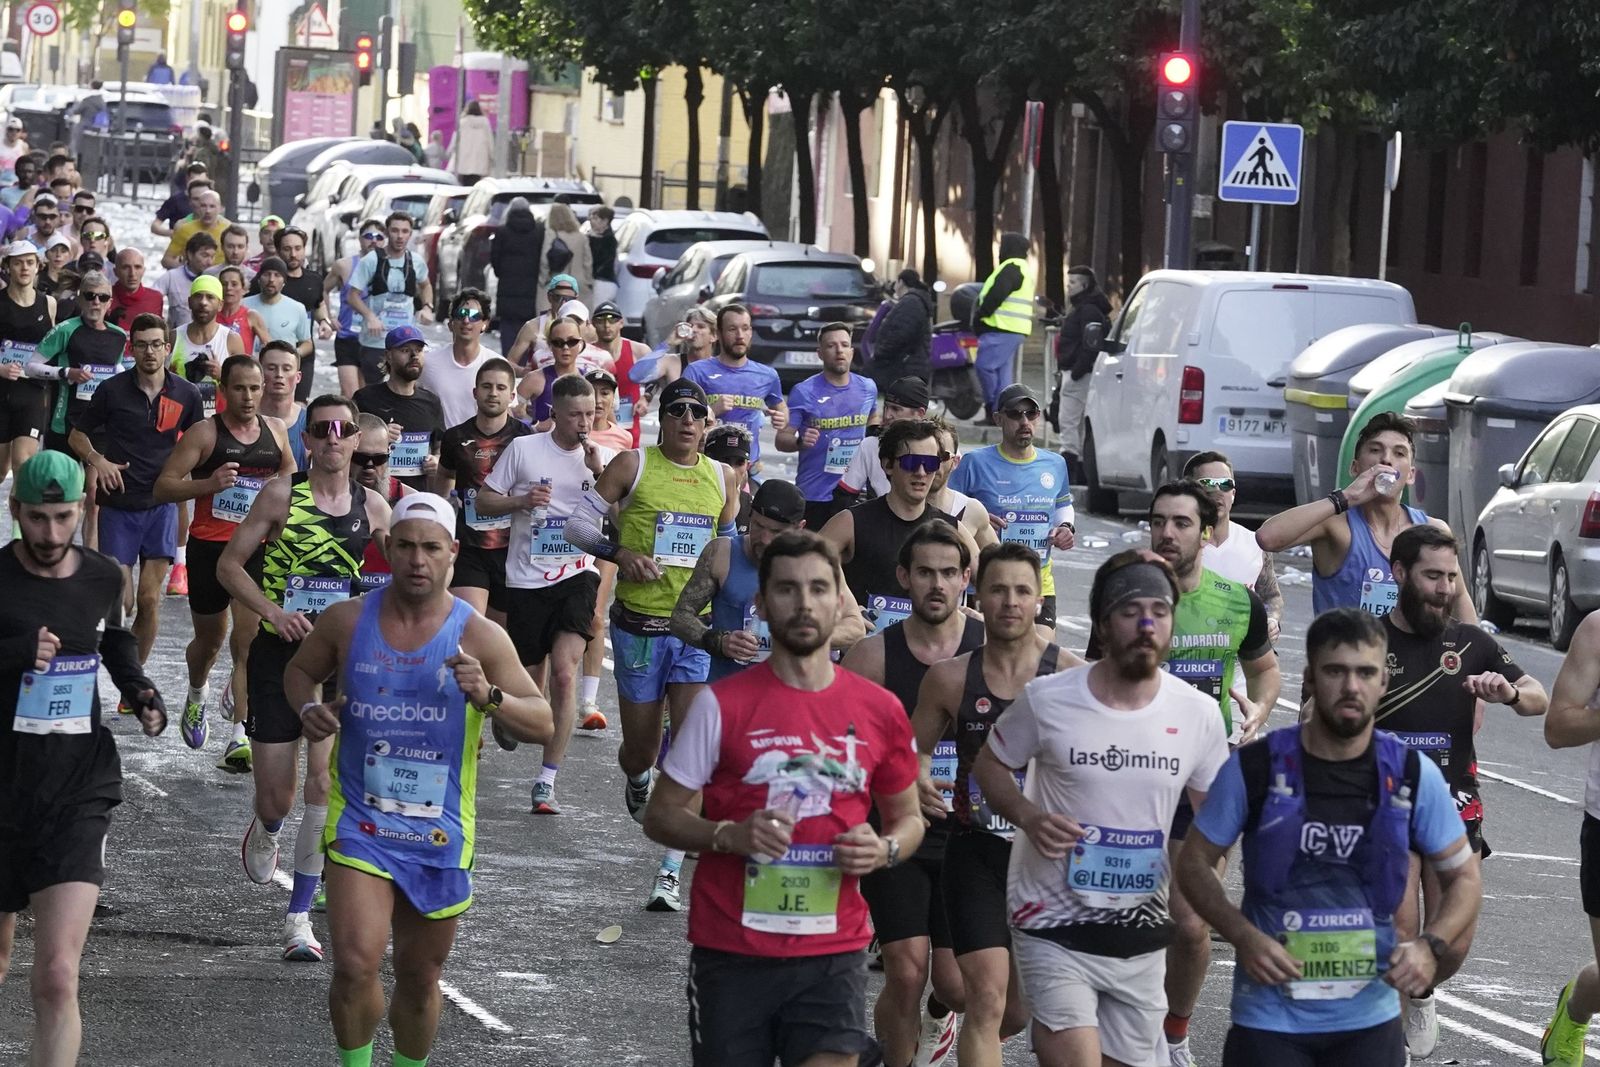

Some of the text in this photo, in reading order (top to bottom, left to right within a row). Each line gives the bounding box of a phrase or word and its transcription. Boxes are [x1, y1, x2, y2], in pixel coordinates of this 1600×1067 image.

[33, 13, 53, 25] 30
[1228, 419, 1287, 433] 9177 MFY
[236, 480, 262, 488] ZURICH
[233, 492, 248, 501] 6559
[219, 498, 250, 513] PALAC
[677, 515, 708, 526] ZURICH
[676, 531, 693, 540] 6274
[541, 543, 574, 553] PAWEL
[671, 542, 696, 555] FEDE
[308, 580, 343, 590] ZURICH
[1214, 580, 1232, 591] 2023
[308, 597, 326, 606] 6192
[1182, 631, 1230, 648] MARATÓN
[54, 660, 91, 672] ZURICH
[1175, 663, 1215, 673] ZURICH
[53, 684, 72, 696] 5853
[48, 700, 71, 716] FER
[1403, 736, 1441, 746] ZURICH
[393, 768, 418, 780] 9729
[387, 781, 418, 795] JOSE
[1105, 832, 1155, 846] ZURICH
[1300, 821, 1365, 858] CV
[781, 850, 834, 863] ZURICH
[1104, 856, 1132, 869] 9316
[780, 875, 810, 889] 2930
[1073, 869, 1155, 890] @LEIVA95
[777, 893, 810, 913] J.E.
[1307, 913, 1364, 928] ZURICH
[1310, 941, 1341, 954] 3106
